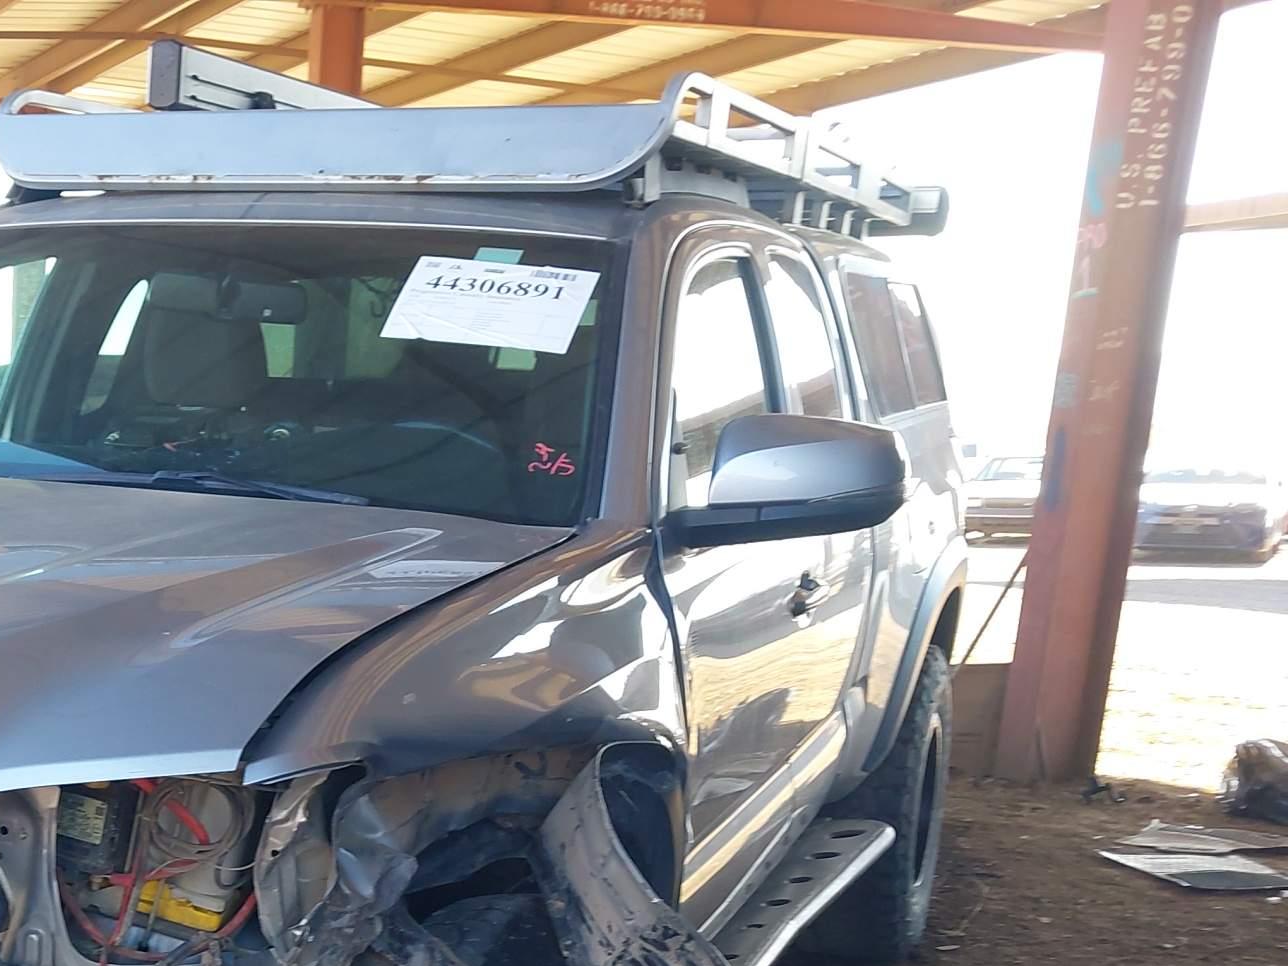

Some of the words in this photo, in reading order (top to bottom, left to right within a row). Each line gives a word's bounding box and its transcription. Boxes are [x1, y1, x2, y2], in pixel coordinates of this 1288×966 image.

[1127, 12, 1168, 134] PREFAB
[1115, 151, 1143, 209] U.S.
[426, 274, 565, 300] 44306891
